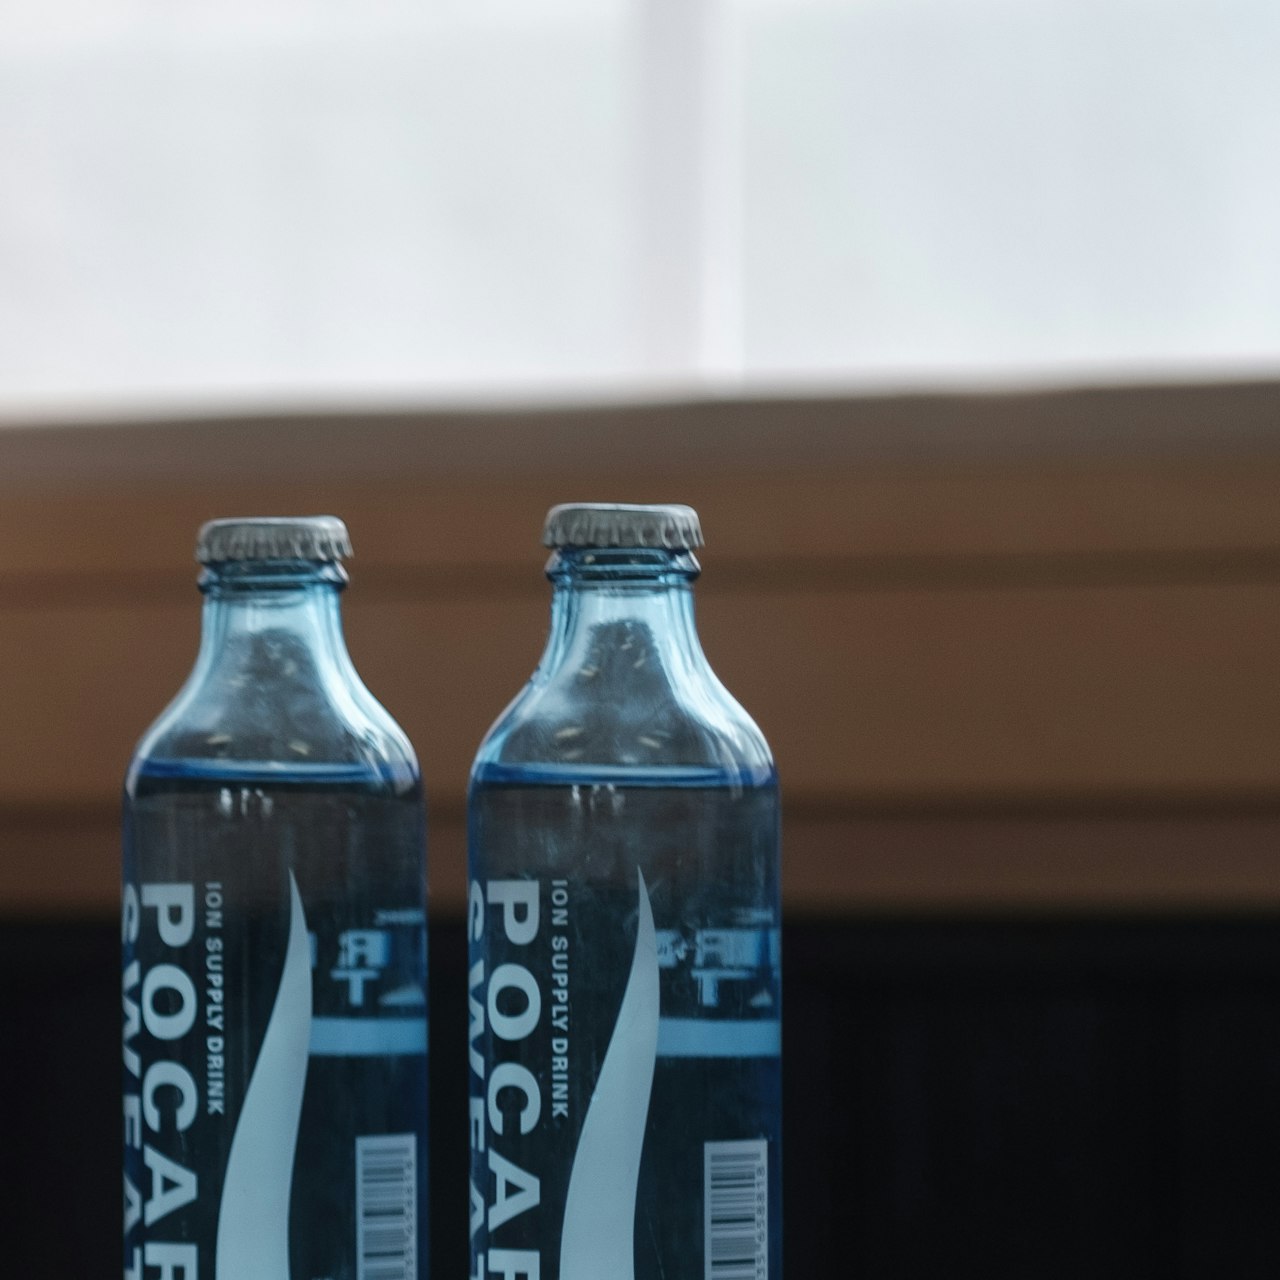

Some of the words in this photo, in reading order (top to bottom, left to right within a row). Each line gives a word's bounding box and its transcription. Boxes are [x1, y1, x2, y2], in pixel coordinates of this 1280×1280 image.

[205, 881, 223, 929] ION
[551, 879, 569, 926] ION
[205, 936, 224, 1032] SUPPLY
[551, 935, 569, 1032] SUPPLY
[206, 1037, 225, 1116] DRINK
[551, 1038, 569, 1119] DRINK
